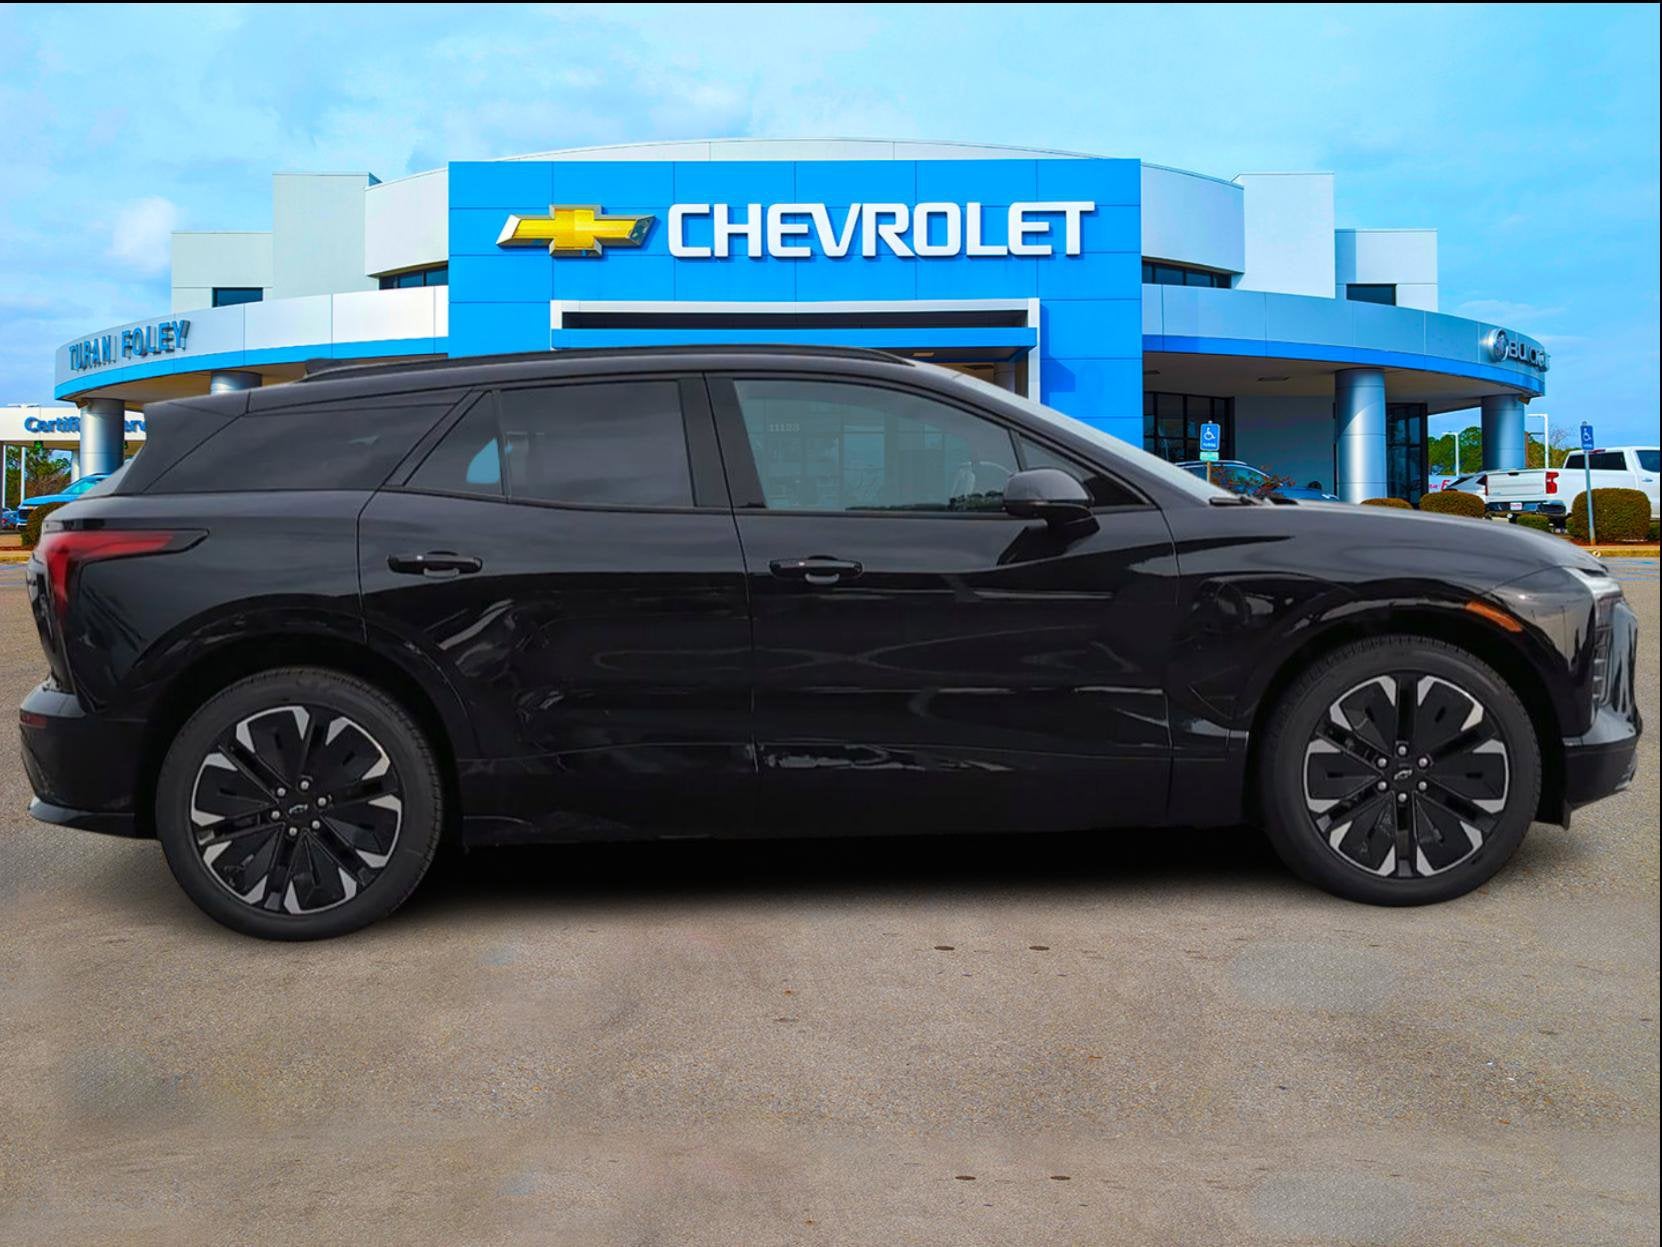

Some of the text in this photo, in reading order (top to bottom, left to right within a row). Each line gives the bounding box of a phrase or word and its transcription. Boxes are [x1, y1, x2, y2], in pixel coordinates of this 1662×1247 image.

[668, 201, 1096, 258] CHEVROLET
[69, 319, 190, 371] TURAN FOLEY
